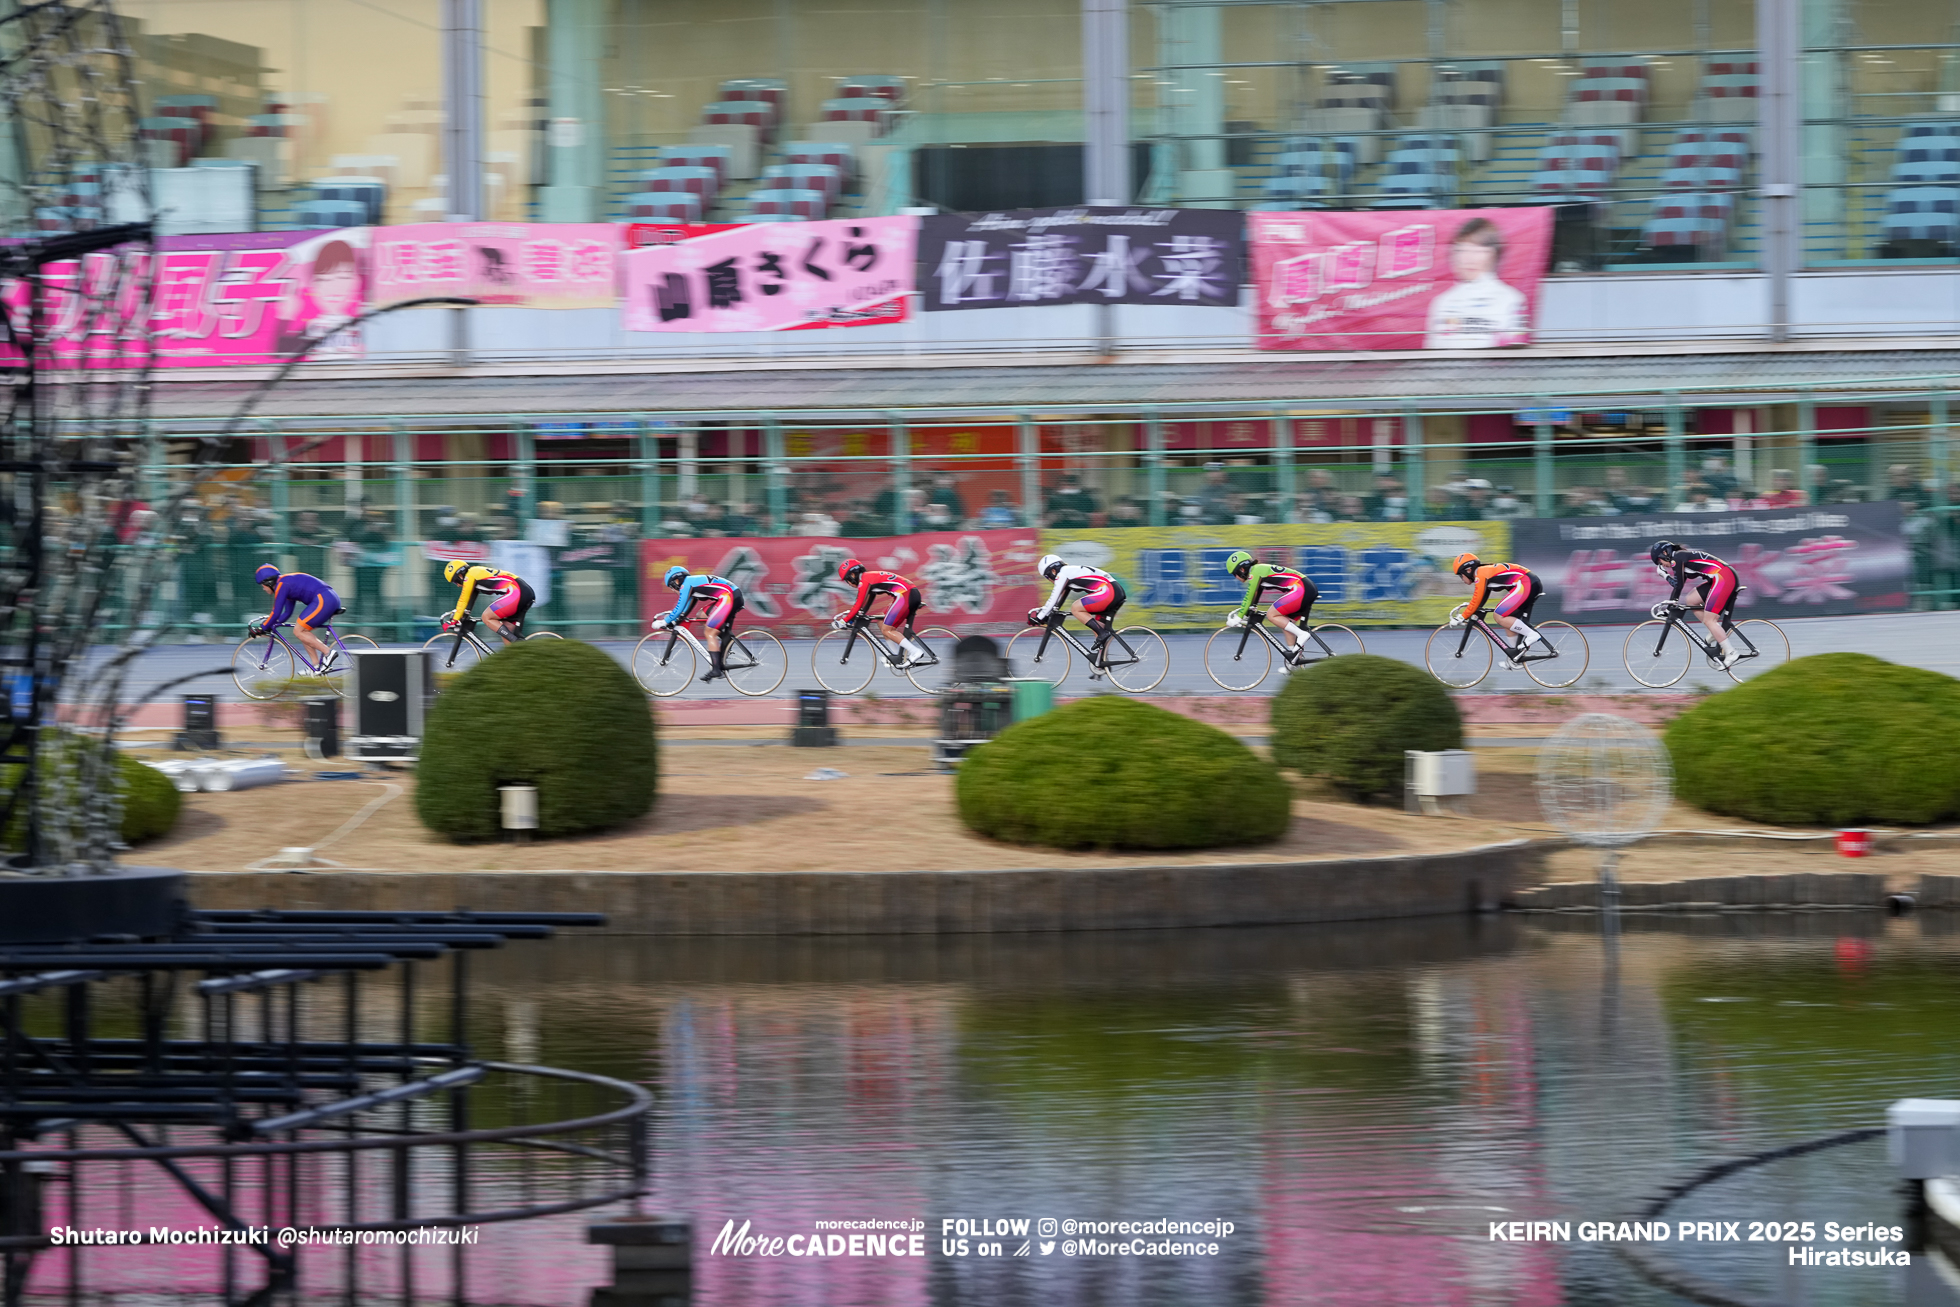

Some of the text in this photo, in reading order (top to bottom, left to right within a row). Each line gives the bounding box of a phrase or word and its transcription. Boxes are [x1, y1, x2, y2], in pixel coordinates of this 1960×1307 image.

[933, 234, 1230, 304] 佐藤水菜
[861, 626, 890, 656] BRIDGESTONE
[1056, 625, 1090, 656] BRIDGESTONE
[1255, 622, 1286, 652] BRIDGESTONE
[1477, 619, 1508, 650] BRIDGESTONE
[1675, 618, 1708, 648] BRIDGESTONE
